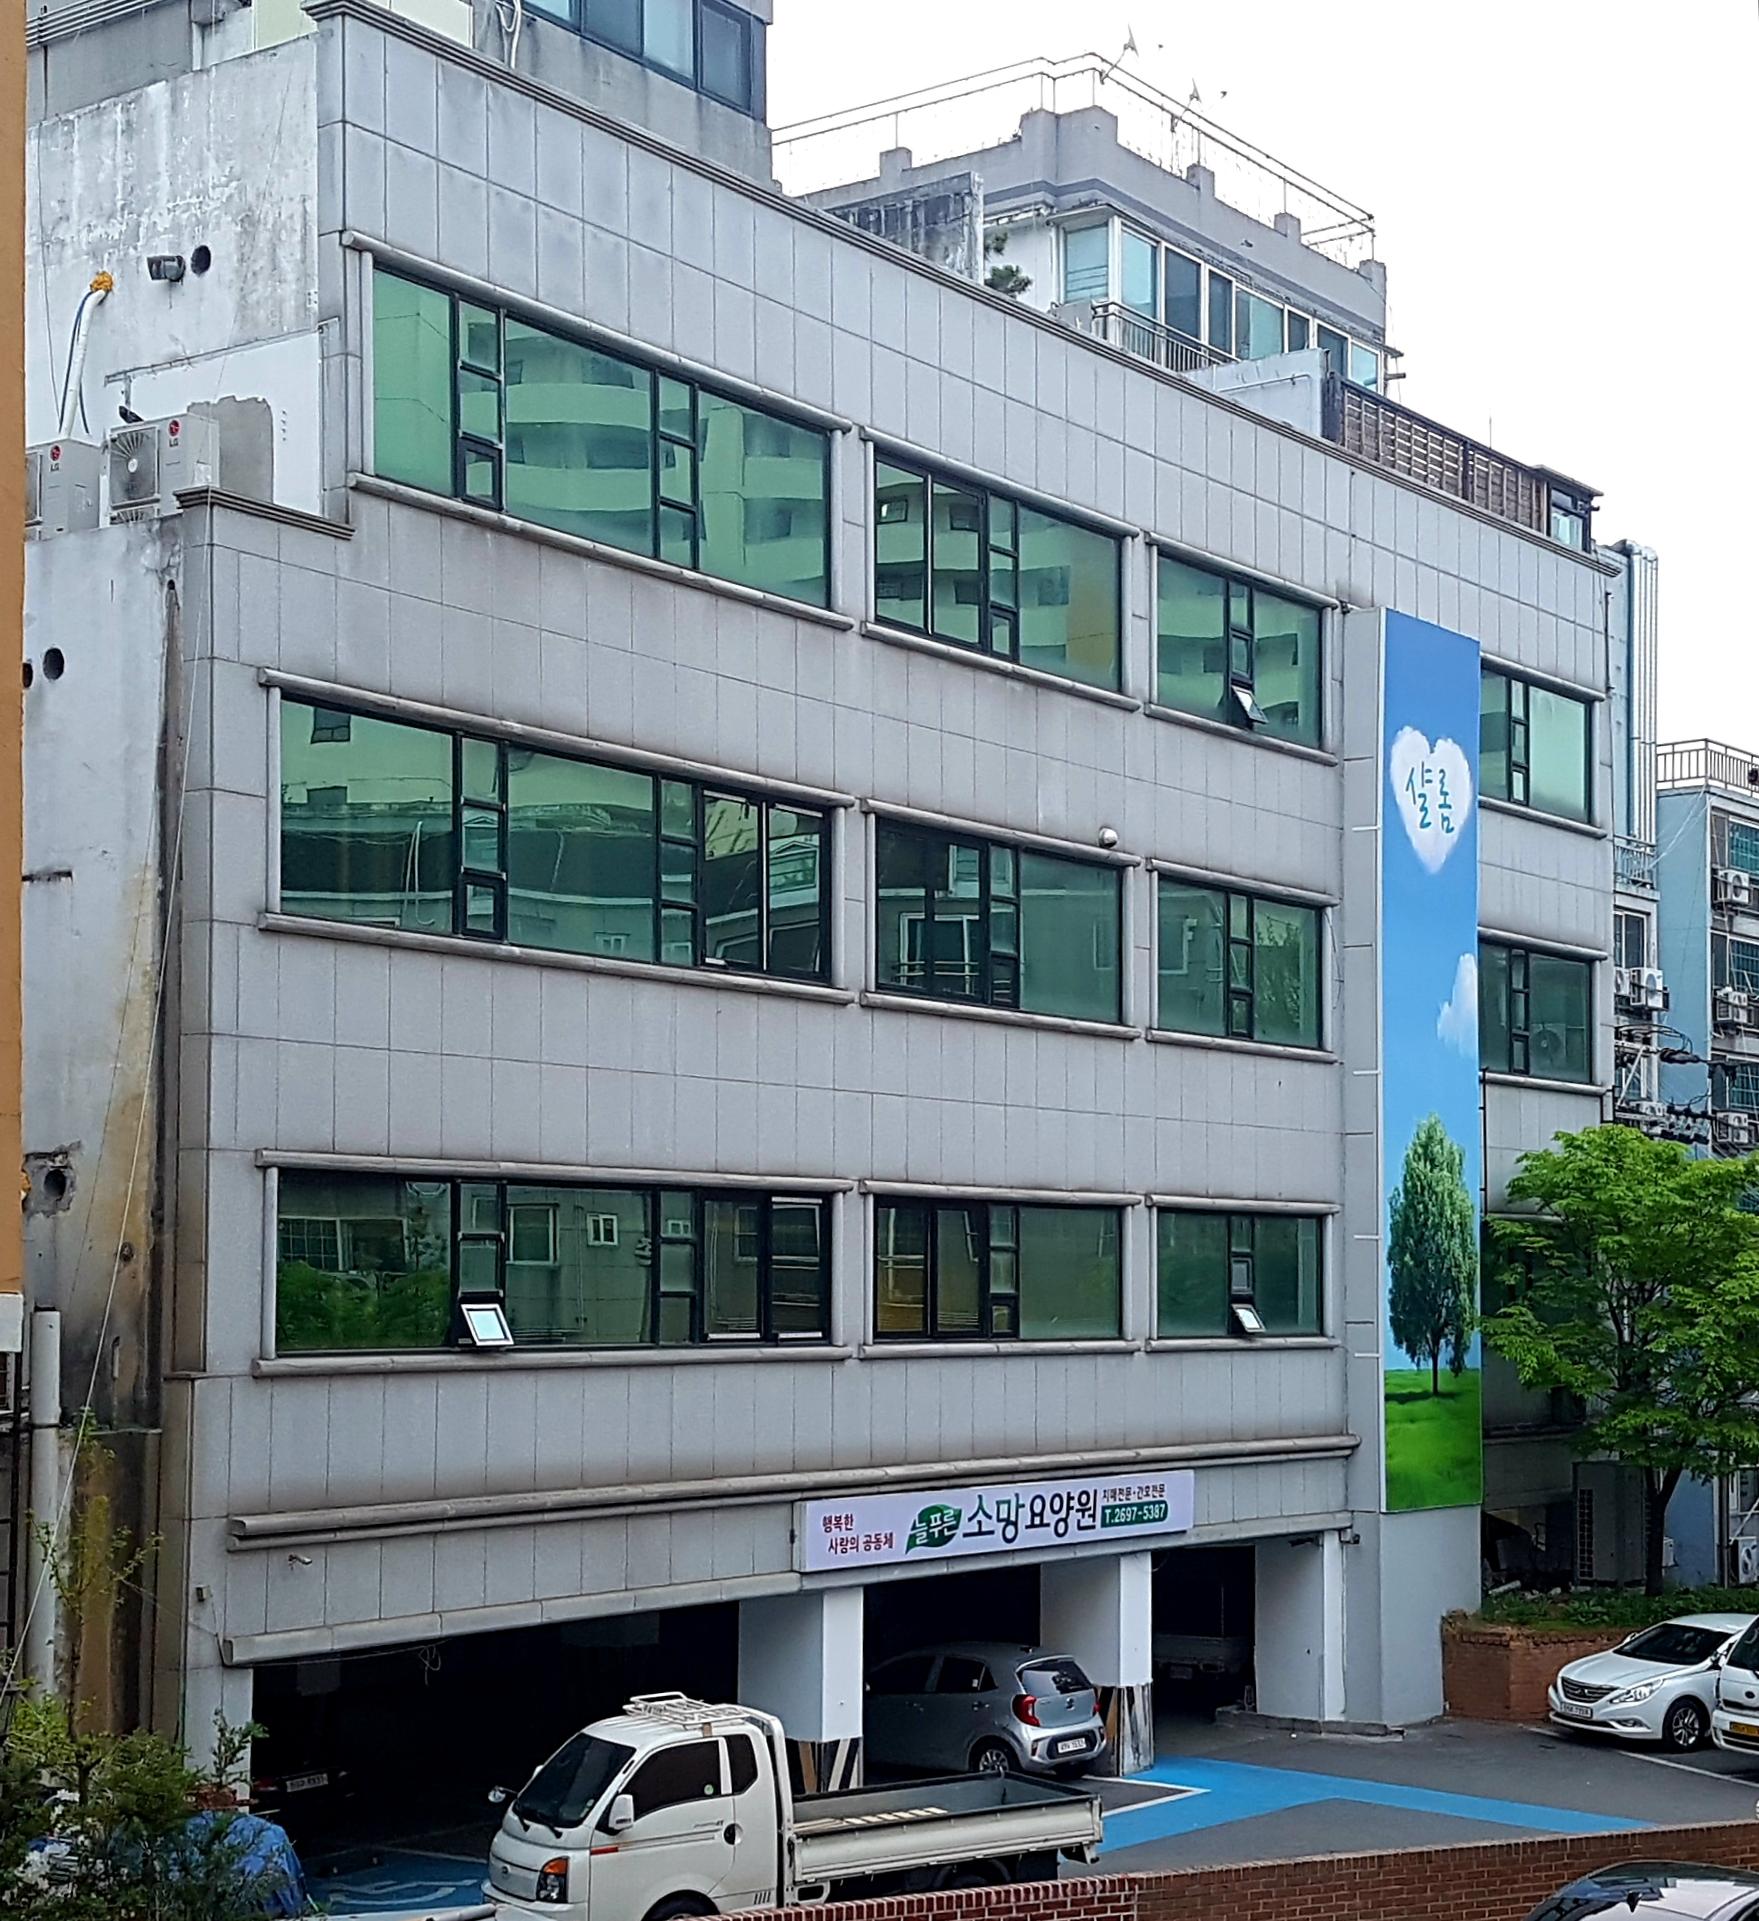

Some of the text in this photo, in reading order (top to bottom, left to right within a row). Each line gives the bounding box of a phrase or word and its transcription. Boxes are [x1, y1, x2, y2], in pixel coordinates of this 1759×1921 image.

[169, 438, 179, 447] LG
[50, 463, 60, 472] LG
[1406, 761, 1454, 834] 샬롬
[822, 1513, 854, 1533] 행복한
[907, 1489, 1098, 1545] 늘푸른 소망요양원
[1105, 1504, 1166, 1524] T.2697-5387
[828, 1532, 894, 1555] 사랑의 공동체
